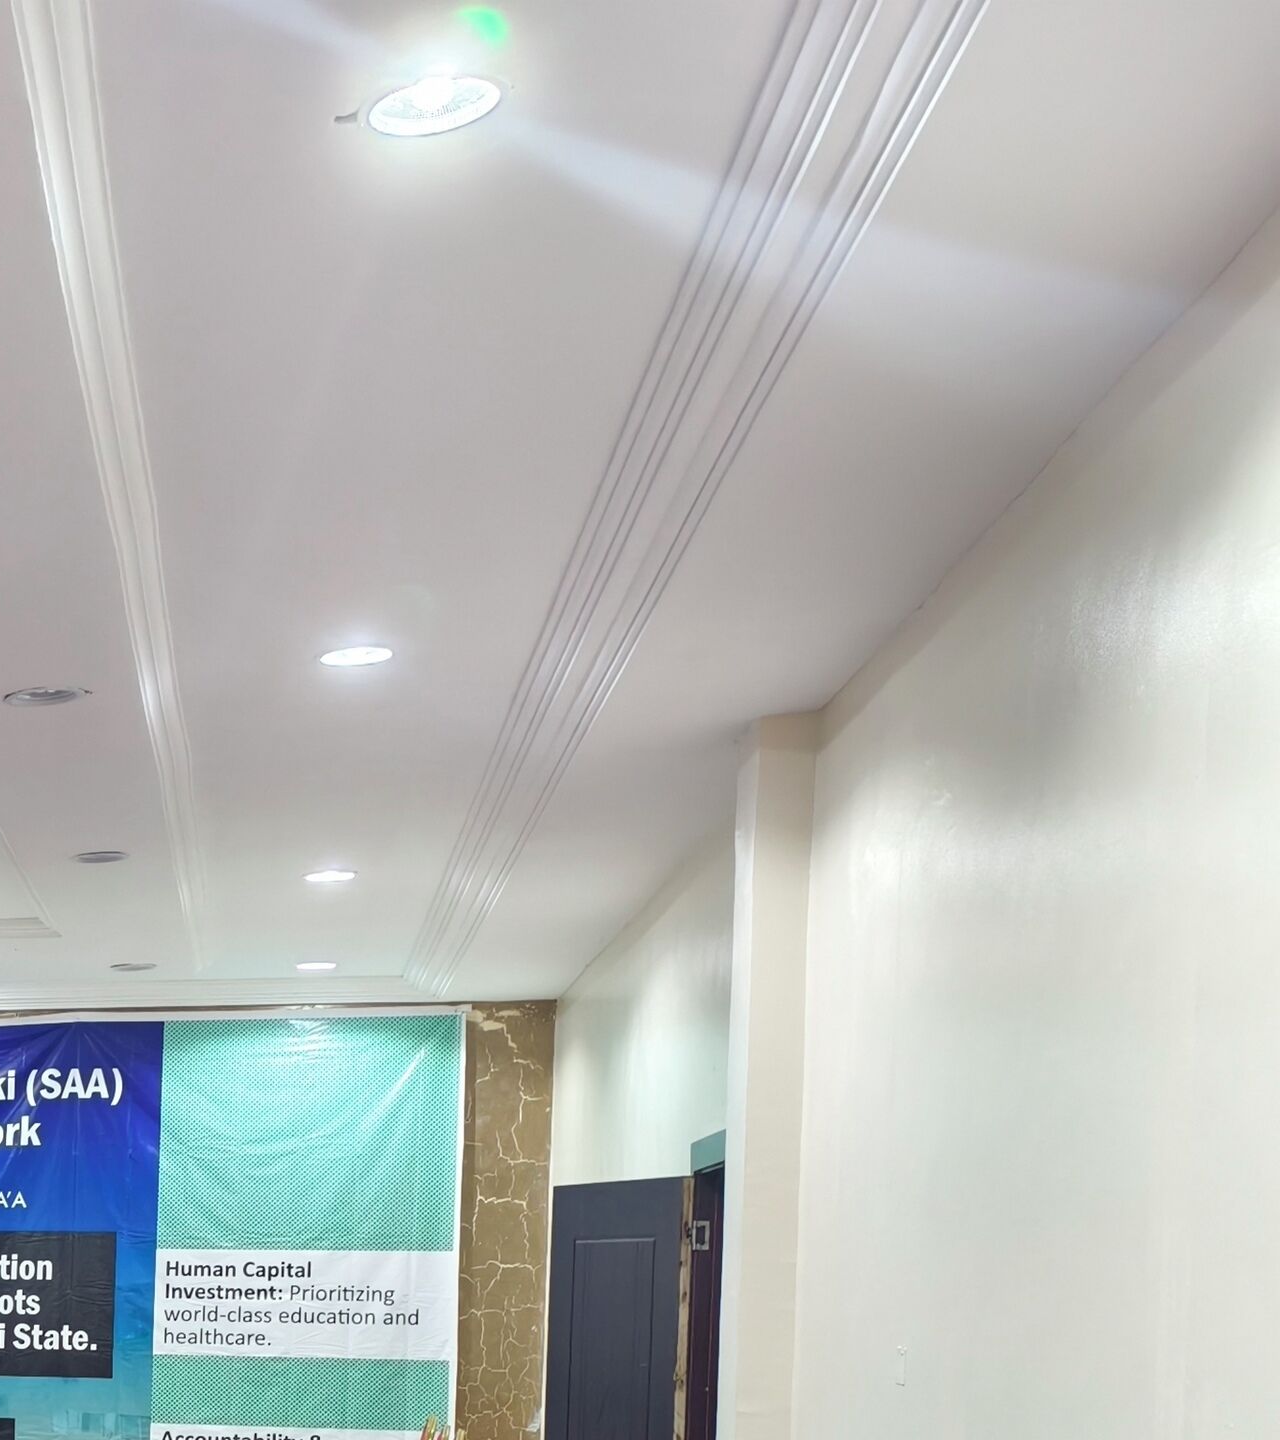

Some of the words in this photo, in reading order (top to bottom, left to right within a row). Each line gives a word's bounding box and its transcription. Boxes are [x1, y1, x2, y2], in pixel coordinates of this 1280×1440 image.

[26, 1067, 124, 1107] (SAA)
[165, 1260, 237, 1278] Human
[243, 1261, 312, 1281] Capital
[165, 1283, 284, 1301] Investment:
[289, 1284, 395, 1306] Prioritizing
[163, 1306, 272, 1324] world-class
[278, 1307, 376, 1326] education
[382, 1308, 420, 1326] and
[12, 1323, 98, 1351] State.
[163, 1327, 272, 1347] healthcare.
